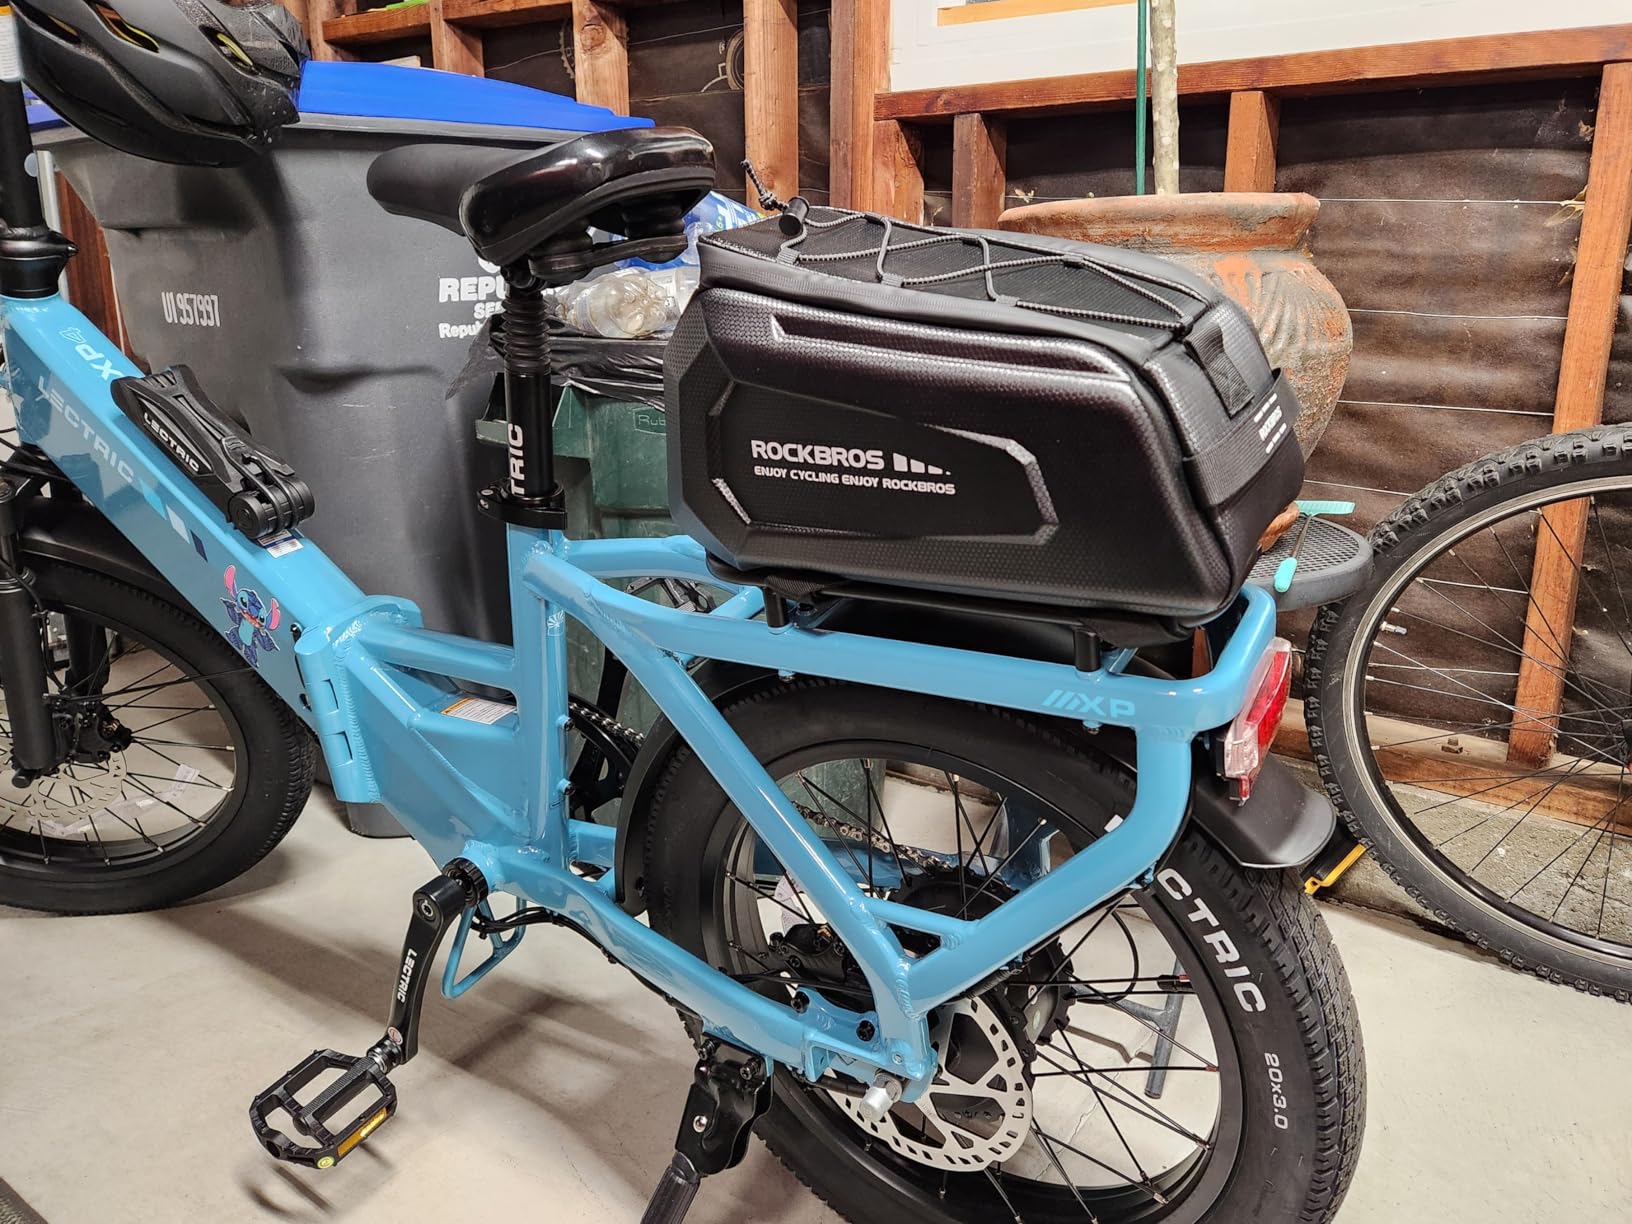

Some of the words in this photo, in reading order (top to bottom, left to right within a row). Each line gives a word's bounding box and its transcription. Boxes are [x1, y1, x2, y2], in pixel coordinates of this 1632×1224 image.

[36, 375, 134, 483] LECTRIC
[144, 412, 199, 471] LECTRIC
[507, 423, 525, 495] TRIC
[751, 440, 885, 470] ROCKBROS
[754, 466, 787, 478] ENJOY
[790, 469, 839, 484] CYCLING
[842, 474, 879, 488] ENJOY
[882, 478, 956, 495] ROCKBROS
[1157, 868, 1266, 1012] CTRIC
[397, 948, 417, 1003] LECTRIC
[1264, 1052, 1288, 1130] 20x3.0
